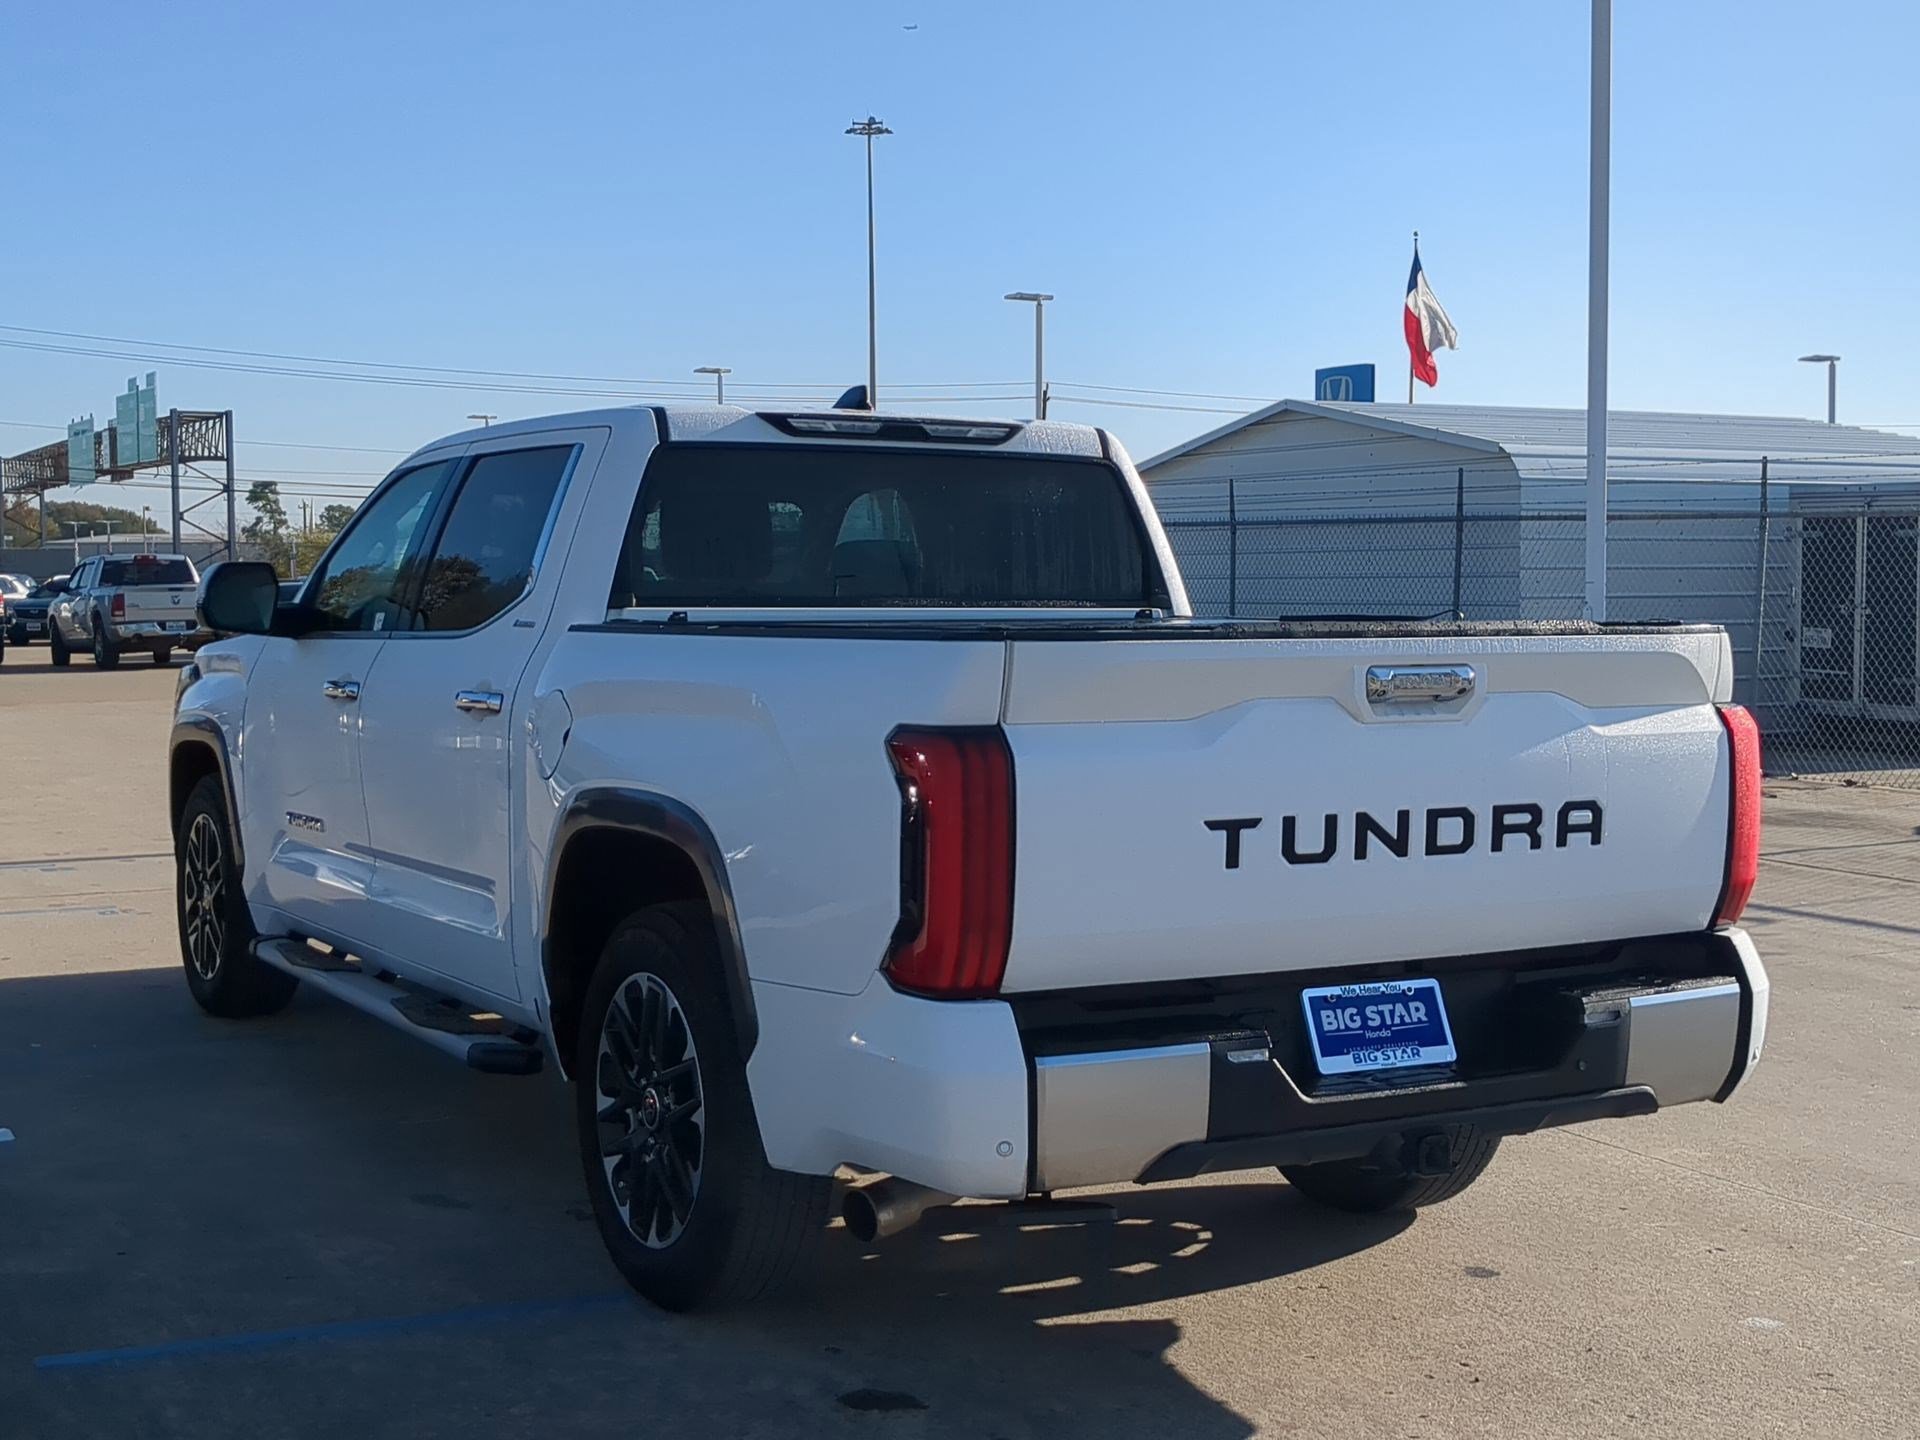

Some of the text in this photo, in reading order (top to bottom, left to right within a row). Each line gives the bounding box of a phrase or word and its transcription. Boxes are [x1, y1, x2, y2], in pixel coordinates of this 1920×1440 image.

[1203, 799, 1602, 869] TUNDRA
[1340, 983, 1401, 996] We Hear You
[1320, 1001, 1428, 1031] BIG STAR
[1365, 1028, 1391, 1039] Honda
[1352, 1047, 1422, 1065] BIG STAR
